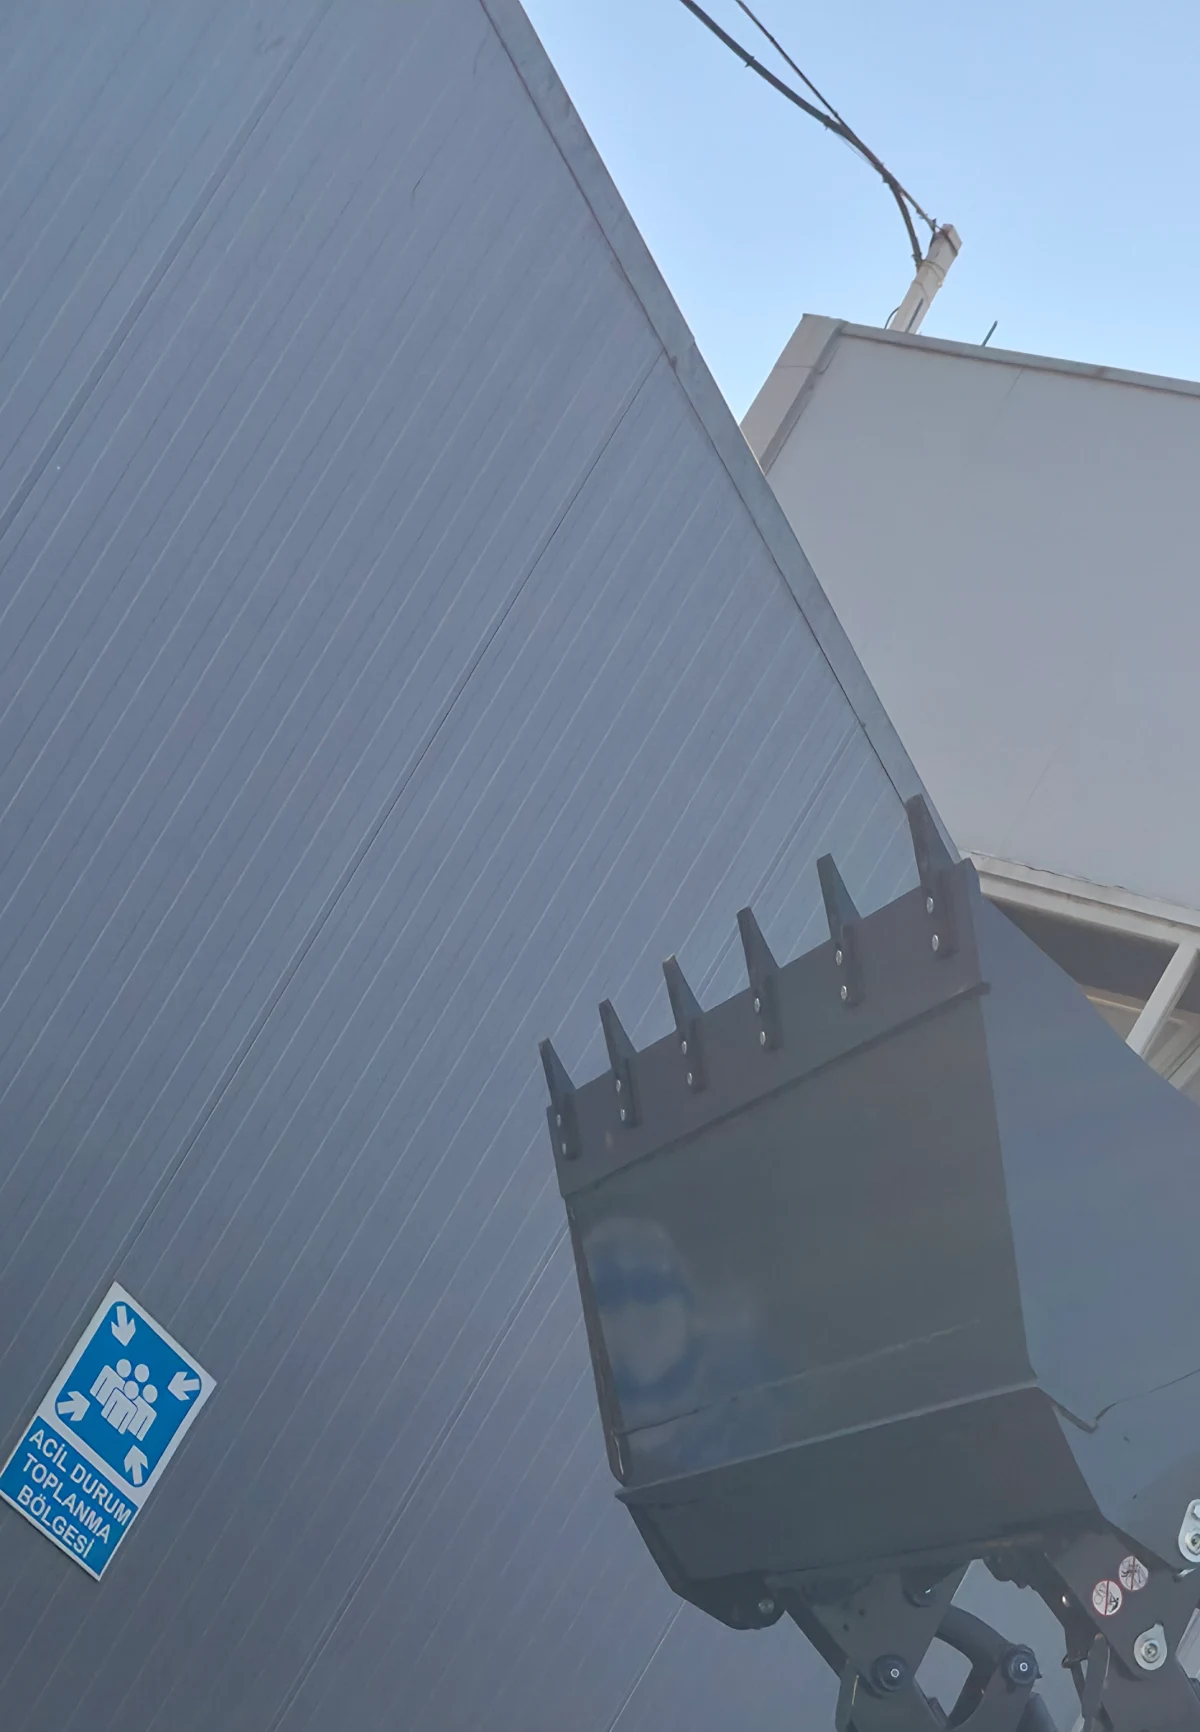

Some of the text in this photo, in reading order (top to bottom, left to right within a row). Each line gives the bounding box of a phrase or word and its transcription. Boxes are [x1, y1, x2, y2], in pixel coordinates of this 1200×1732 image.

[17, 1484, 95, 1559] BÖLGESİ
[23, 1453, 111, 1544] TOPLANMA
[29, 1429, 131, 1526] ACİL DURUM
